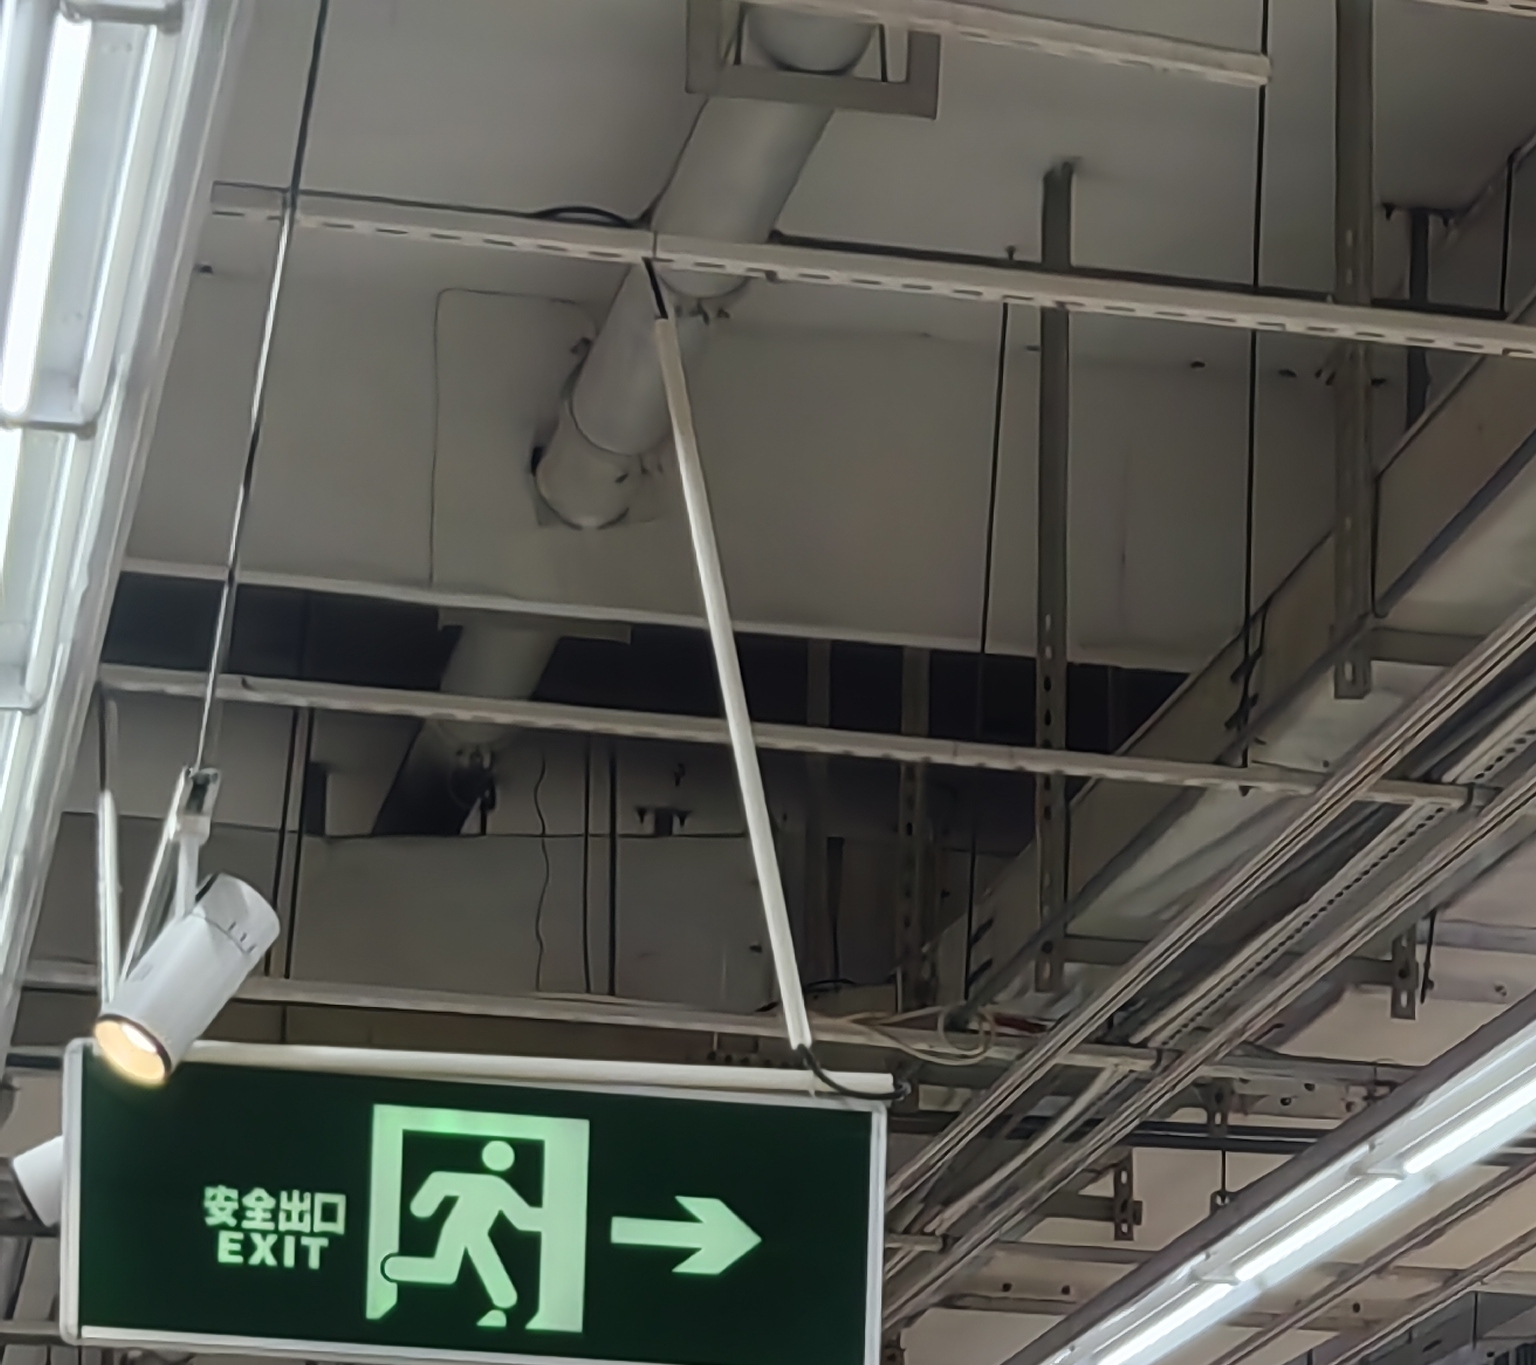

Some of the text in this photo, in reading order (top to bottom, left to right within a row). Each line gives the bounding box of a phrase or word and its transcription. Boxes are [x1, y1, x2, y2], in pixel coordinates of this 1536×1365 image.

[204, 1184, 346, 1236] 安全出口
[216, 1232, 330, 1271] EXIT
